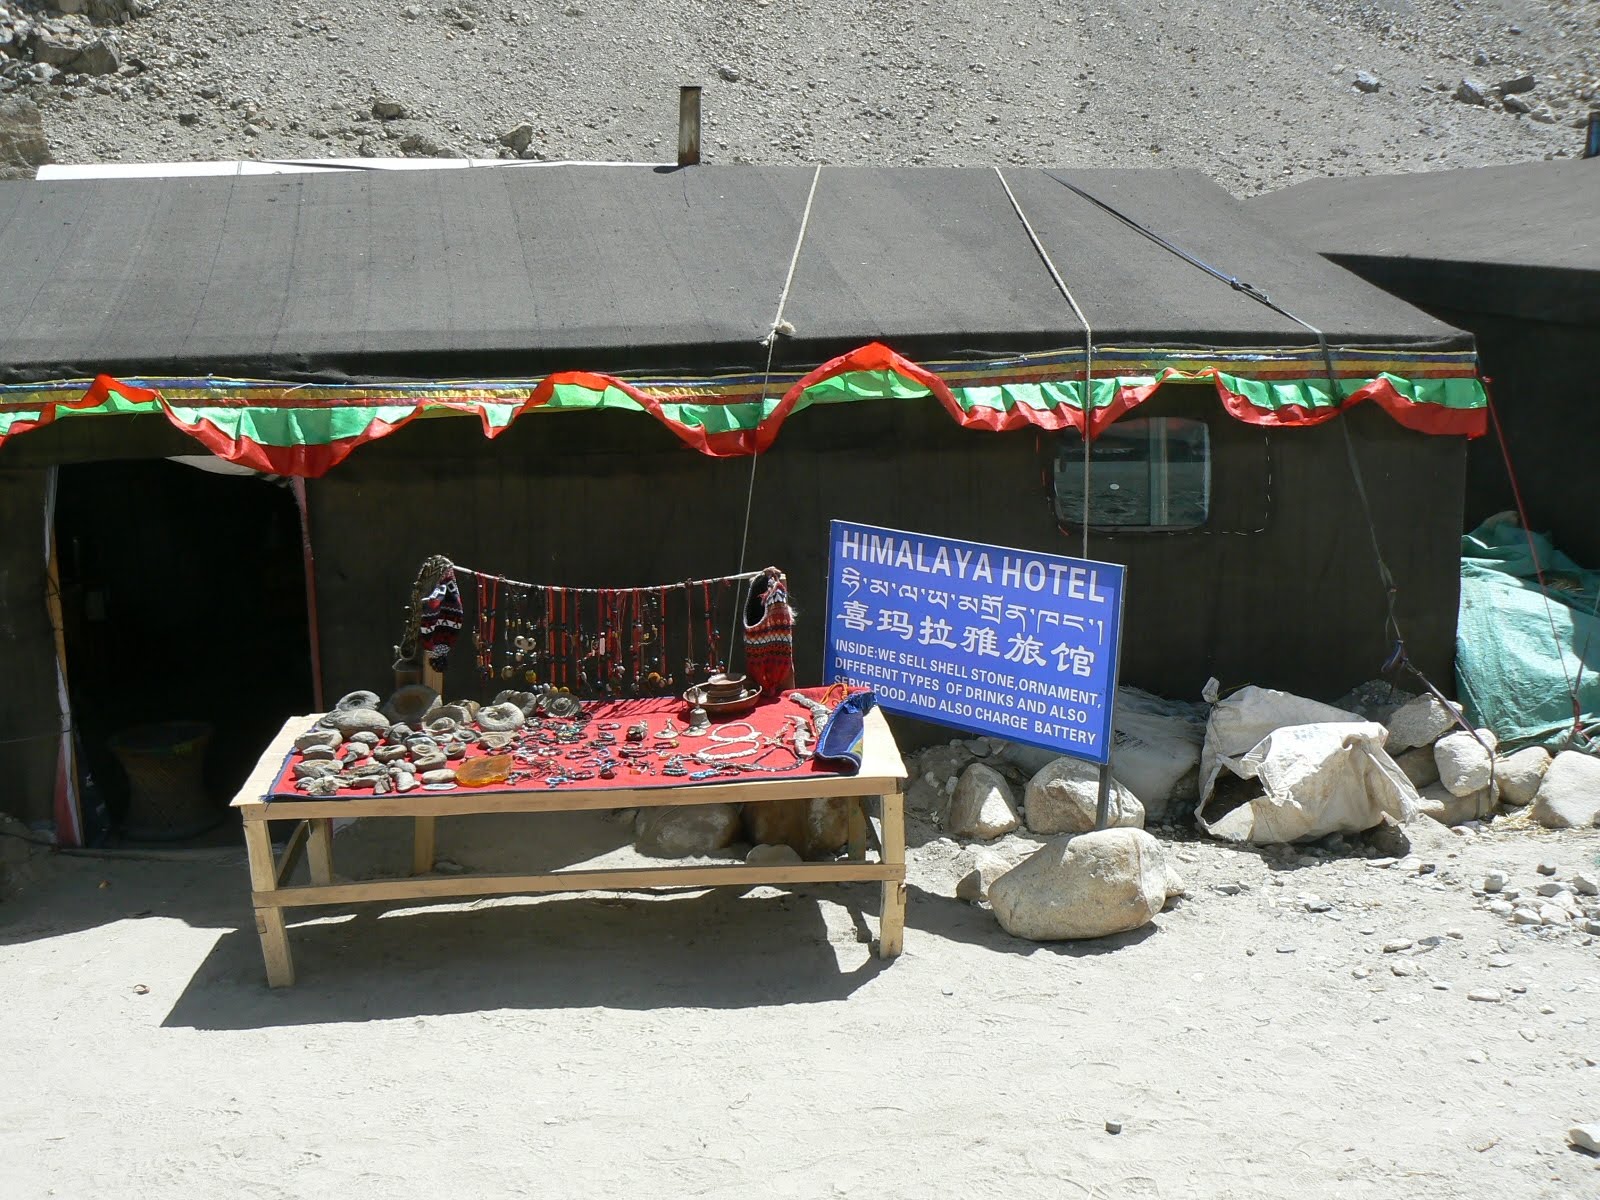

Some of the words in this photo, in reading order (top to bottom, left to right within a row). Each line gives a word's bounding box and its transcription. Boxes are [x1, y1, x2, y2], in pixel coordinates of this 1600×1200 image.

[842, 530, 993, 584] HIMALAYA
[1001, 556, 1105, 603] HOTEL
[836, 600, 1095, 677] 喜玛拉雅旅馆
[899, 653, 927, 670] SELL
[930, 660, 968, 679] SHELL
[835, 657, 899, 682] DIFFERENT
[901, 671, 940, 691] TYPES
[946, 682, 963, 696] OF
[965, 686, 1014, 707] DRINKS
[1017, 698, 1047, 715] AND
[1049, 705, 1087, 724] ALSO
[939, 700, 972, 717] ALSO
[975, 707, 1028, 730] CHARGE
[1034, 720, 1096, 745] BATTERY
